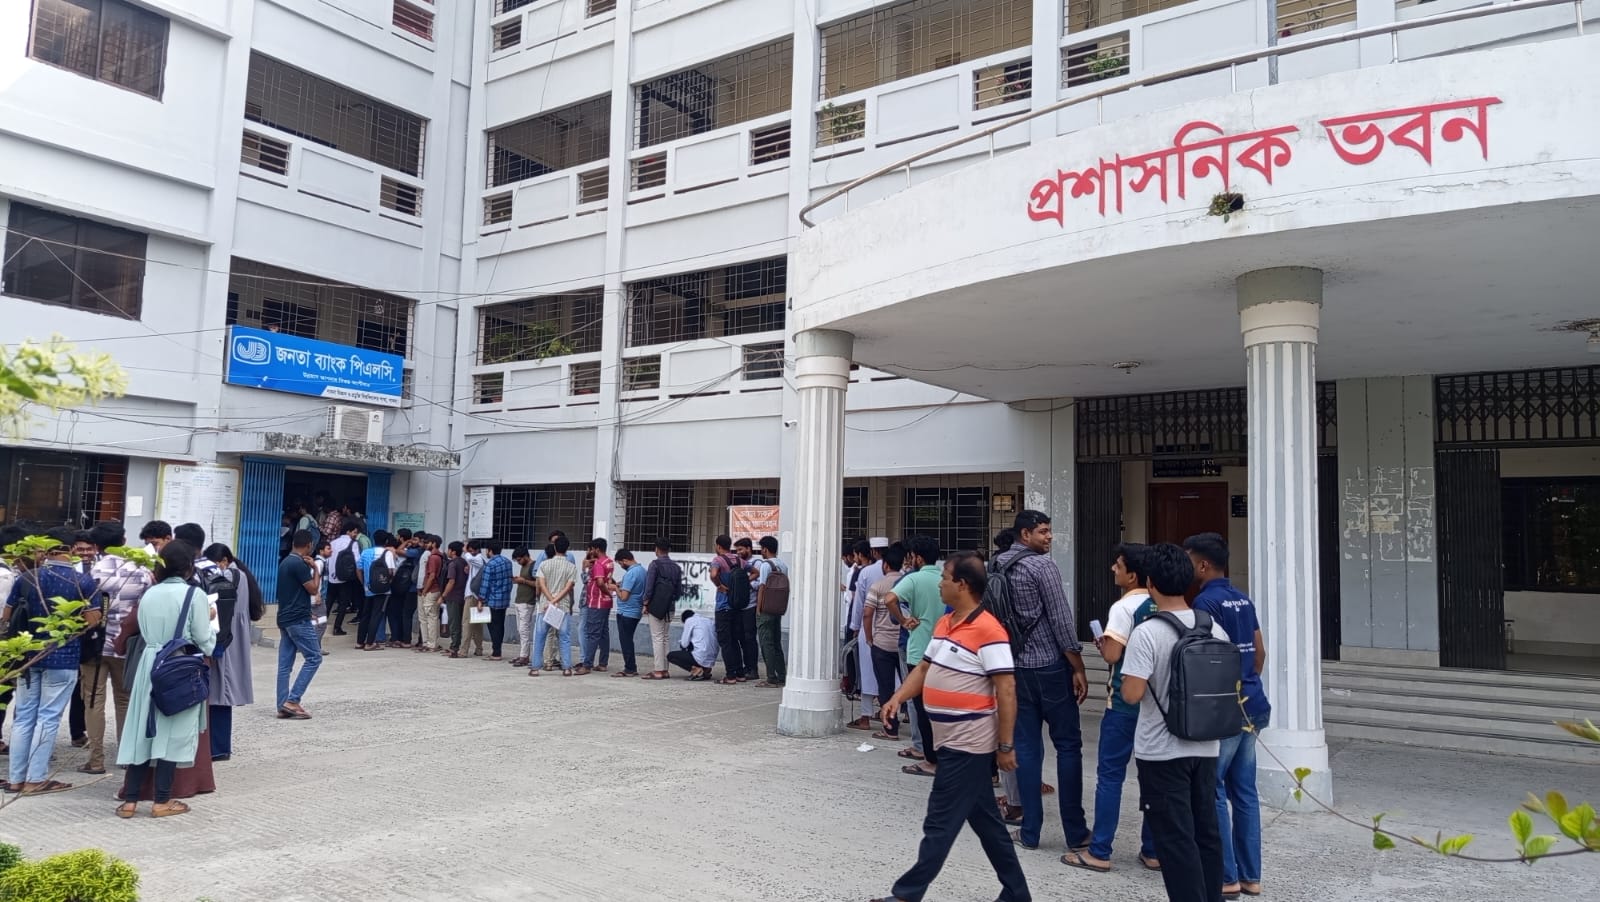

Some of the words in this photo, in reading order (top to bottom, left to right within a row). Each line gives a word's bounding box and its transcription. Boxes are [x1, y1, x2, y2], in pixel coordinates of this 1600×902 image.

[1027, 121, 1299, 228] প্রশাসনিক
[1319, 96, 1503, 166] ভবন
[275, 346, 310, 368] জনতা
[314, 352, 347, 373] ব্যাংক
[349, 355, 397, 382] পিএলসি.
